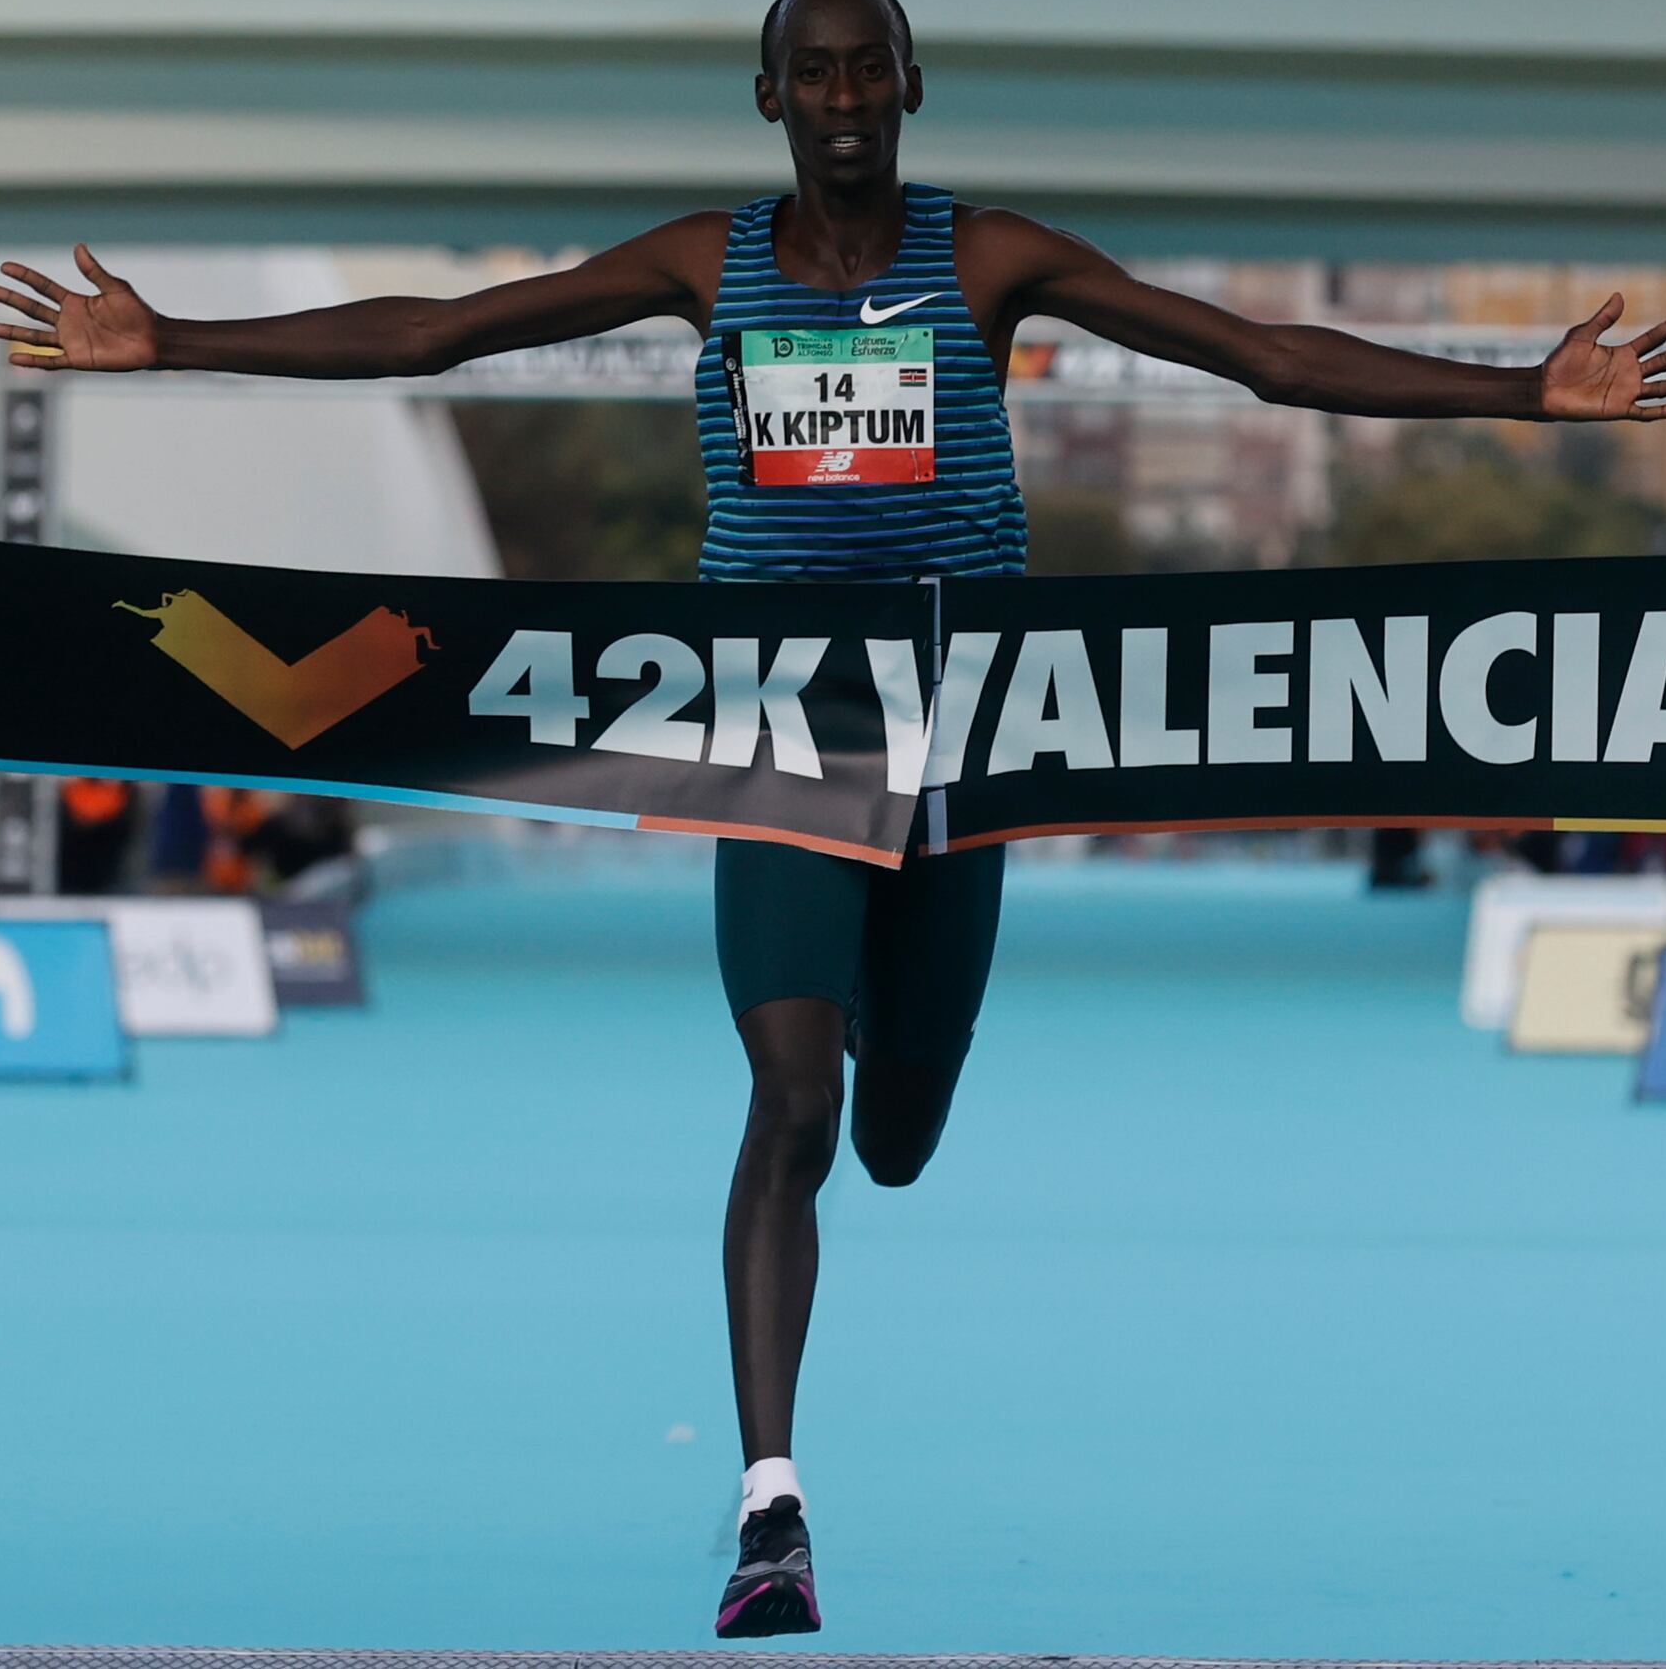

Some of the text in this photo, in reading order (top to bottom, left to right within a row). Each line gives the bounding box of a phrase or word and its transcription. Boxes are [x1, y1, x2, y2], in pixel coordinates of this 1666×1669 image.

[851, 345, 896, 357] Esfuerzo
[852, 336, 886, 347] Cultura
[814, 373, 855, 403] 14
[754, 409, 925, 446] K KIPTUM
[824, 474, 860, 482] balance
[468, 629, 832, 780] 42K
